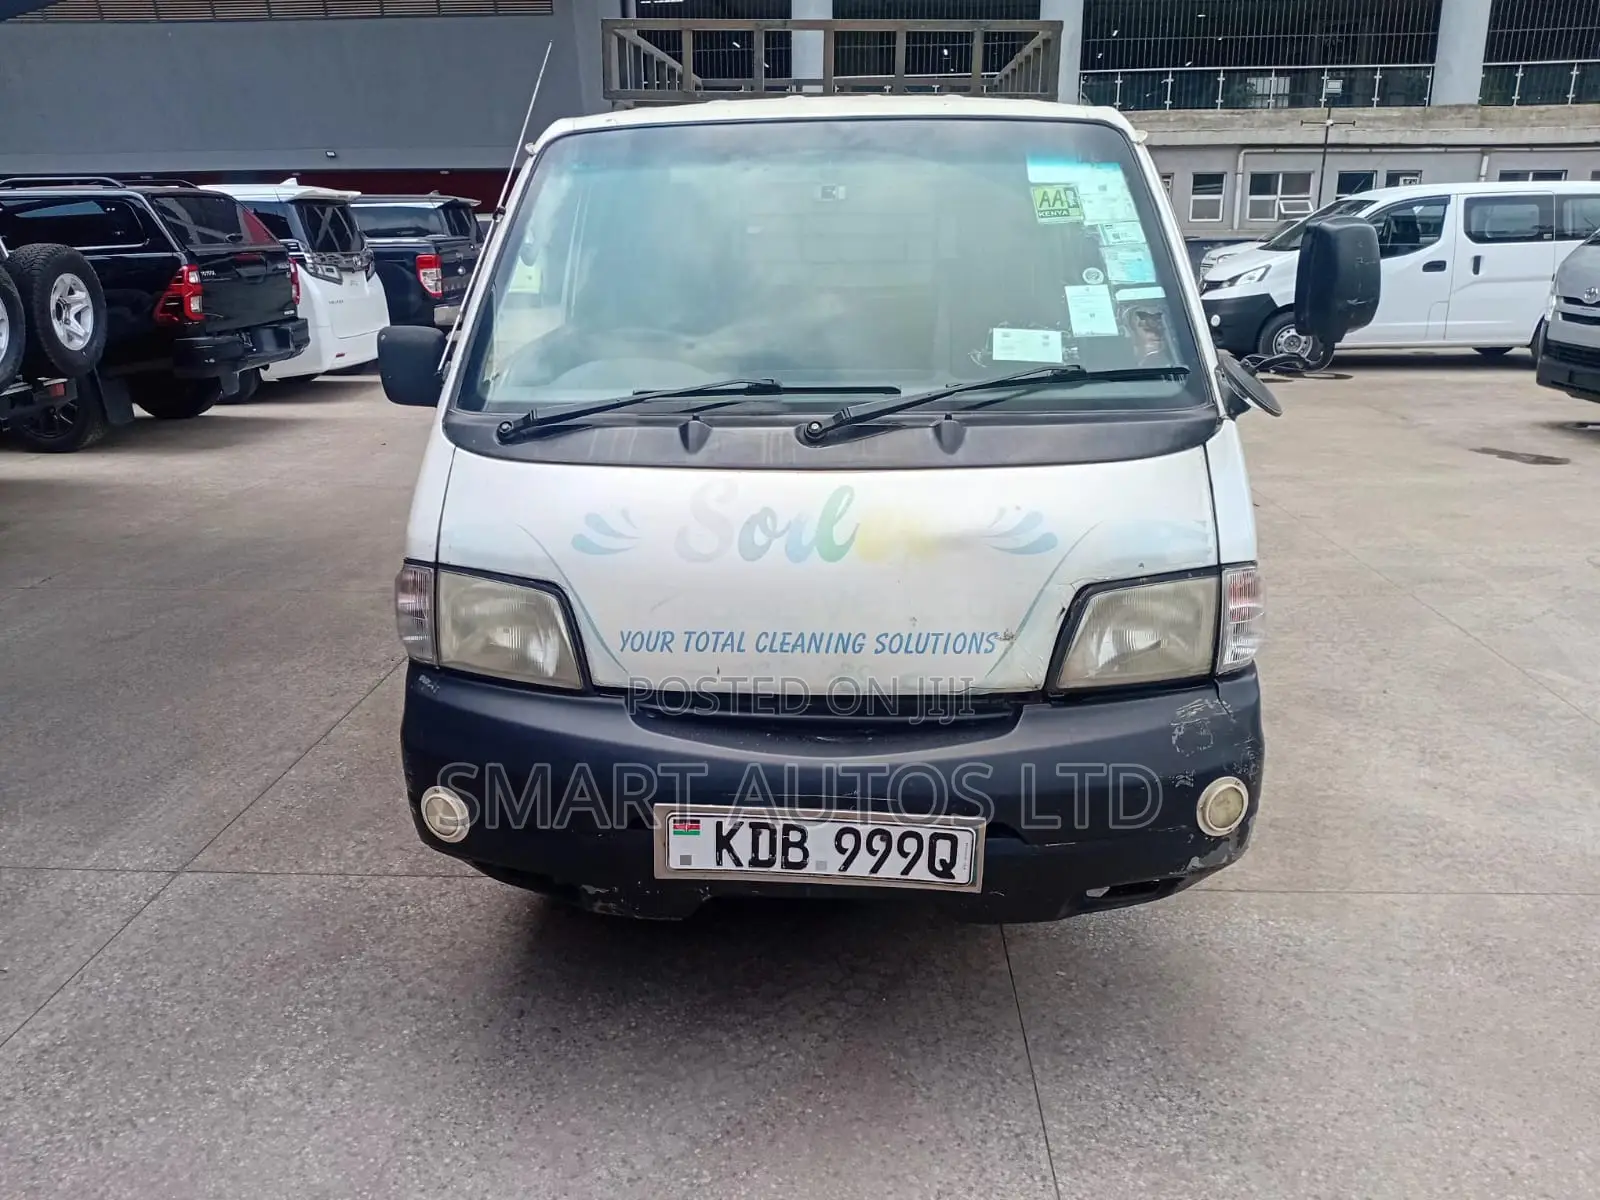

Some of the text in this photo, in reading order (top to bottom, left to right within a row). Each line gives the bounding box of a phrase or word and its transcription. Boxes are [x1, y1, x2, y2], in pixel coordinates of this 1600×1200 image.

[1038, 209, 1069, 218] KENYA
[619, 630, 998, 656] YOUR TOTAL CLEANING SOLUTIONS
[714, 820, 810, 870] KDB
[834, 826, 959, 880] 999Q
